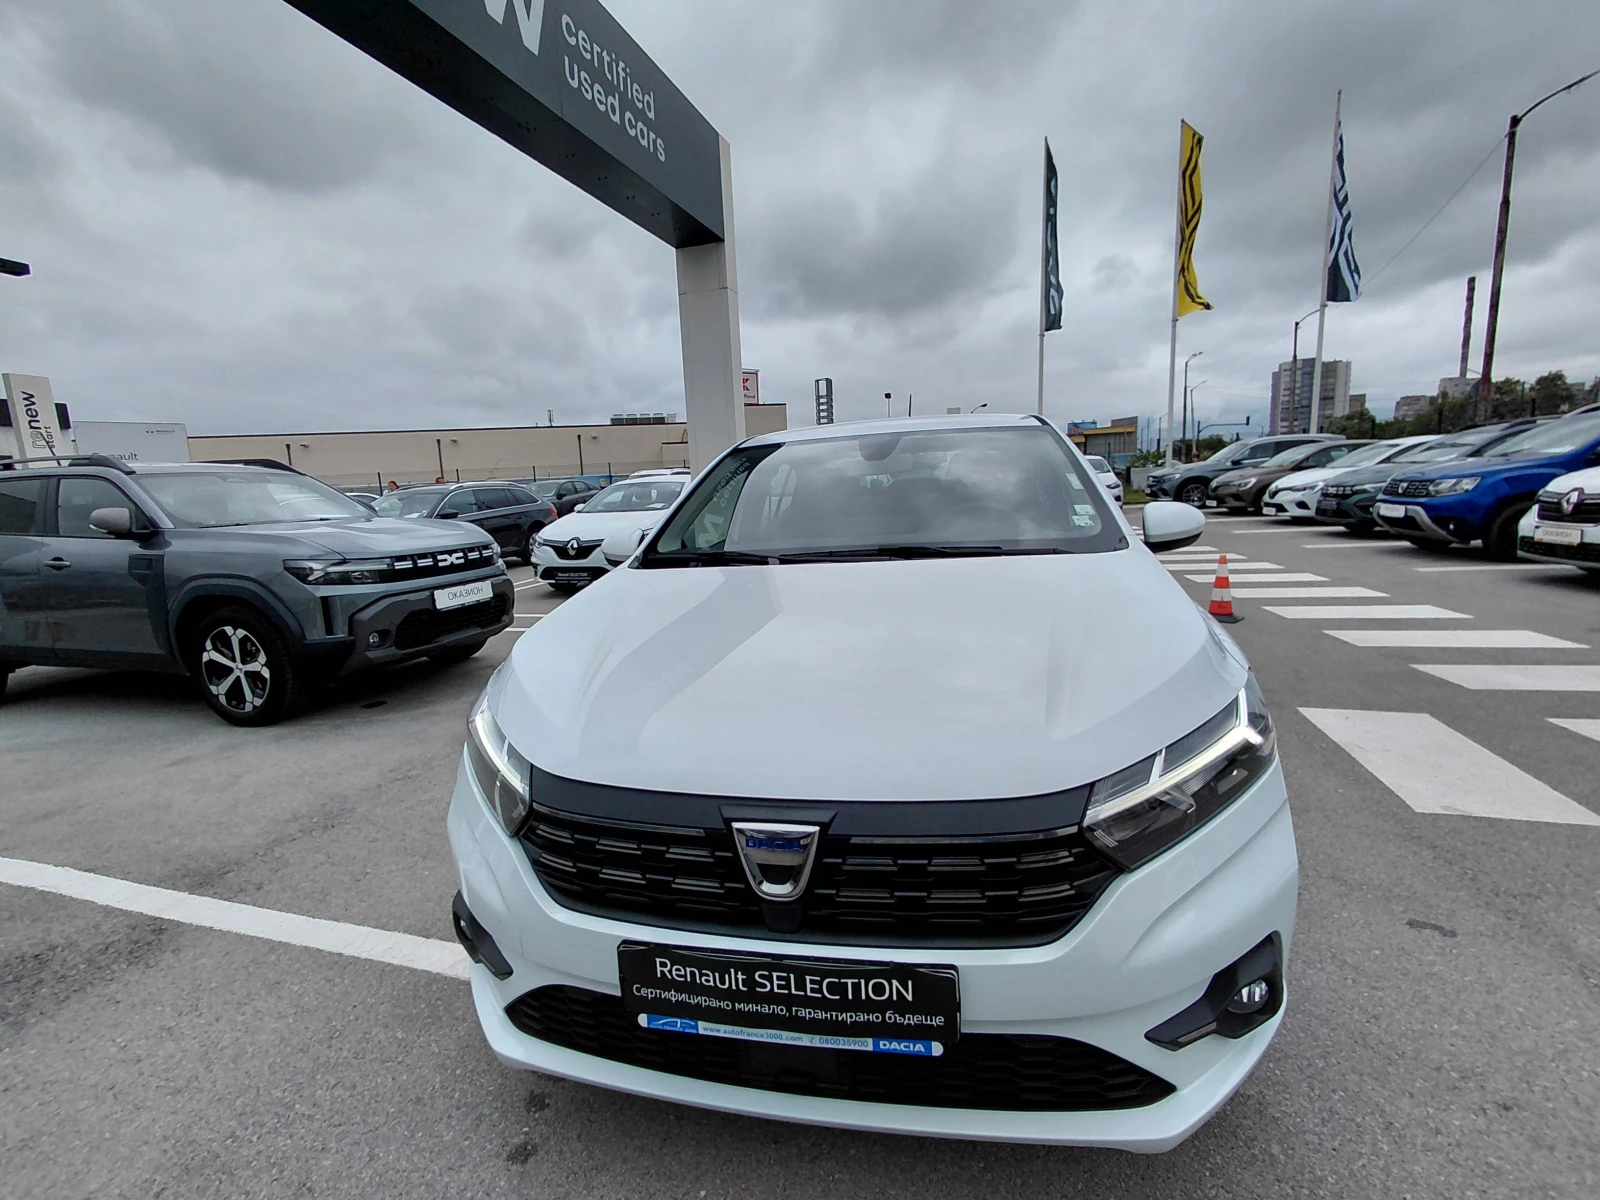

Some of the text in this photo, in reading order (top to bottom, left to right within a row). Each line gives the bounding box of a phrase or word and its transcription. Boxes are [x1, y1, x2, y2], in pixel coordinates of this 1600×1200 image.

[561, 13, 655, 121] certified
[564, 55, 666, 162] used cars
[447, 586, 484, 601] ОКАЗИОН
[655, 957, 914, 1001] Renault SELECTION
[632, 984, 945, 1027] Сертифицирано минало, гарантирано бъдеще
[702, 1026, 803, 1042] www.autofrance3000.com
[879, 1040, 926, 1053] DACIA
